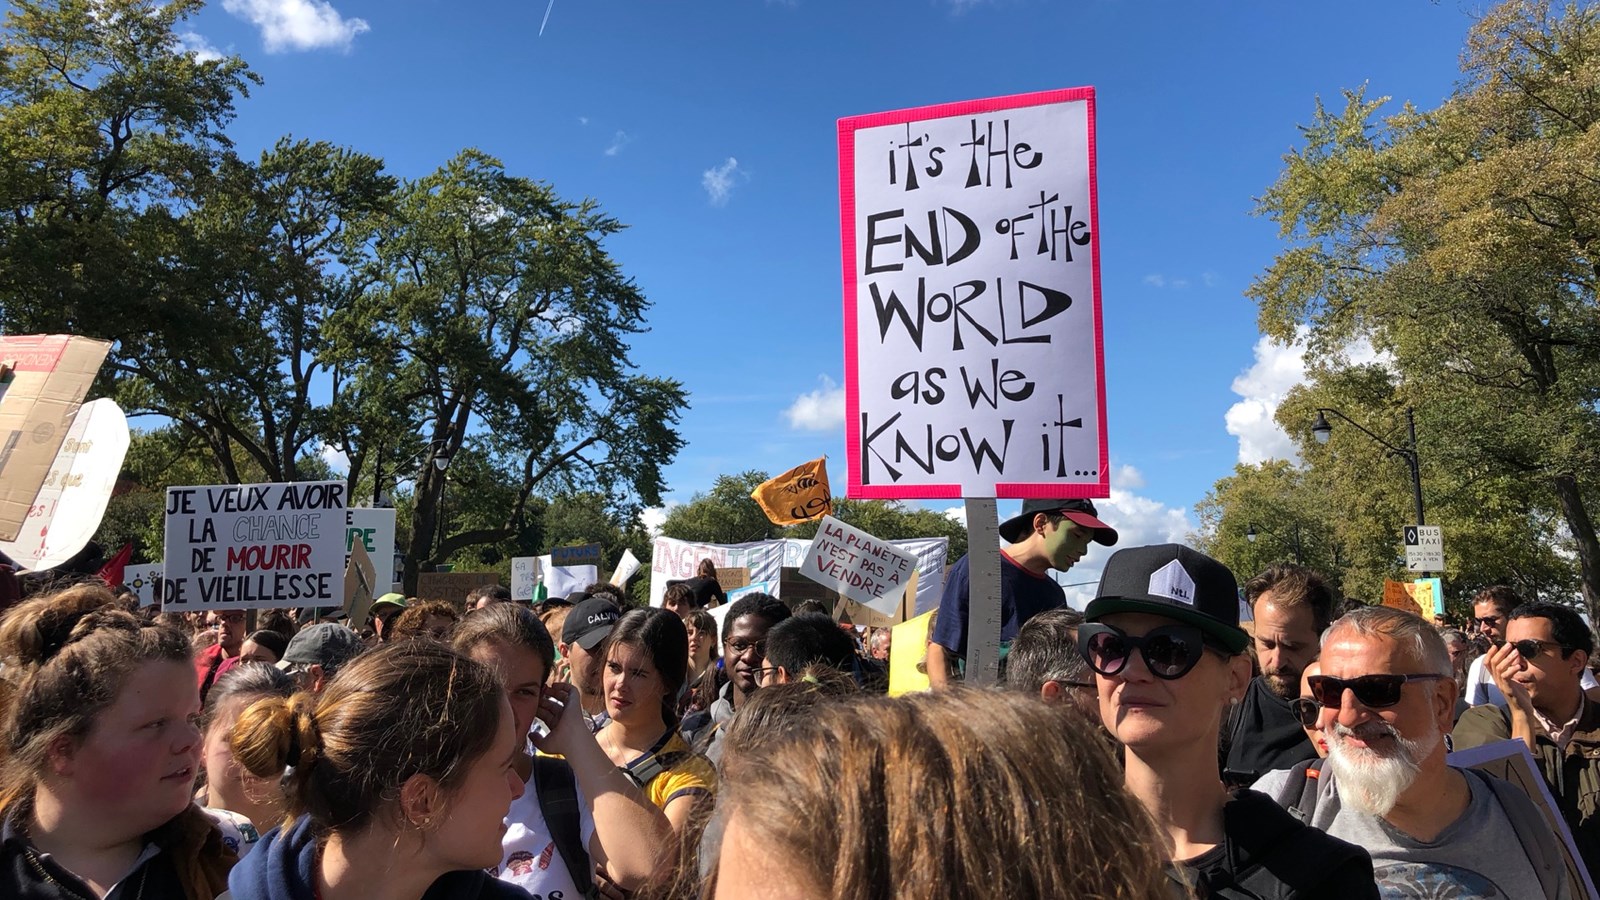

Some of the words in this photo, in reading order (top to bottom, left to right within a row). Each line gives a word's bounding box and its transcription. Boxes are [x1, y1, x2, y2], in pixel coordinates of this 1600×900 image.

[889, 122, 946, 191] it's
[864, 206, 981, 276] END
[891, 367, 947, 405] as
[1042, 393, 1097, 478] it...
[166, 489, 196, 515] JE
[207, 486, 271, 513] VEUX
[277, 483, 344, 511] AVOIR
[189, 518, 217, 544] LA
[232, 512, 322, 543] CHANCE
[824, 523, 844, 541] LA
[846, 533, 909, 571] PLANÈTE
[191, 547, 216, 573] DE
[226, 543, 313, 572] MOURIR
[816, 539, 859, 564] N'EST
[860, 558, 885, 578] PAS
[888, 571, 900, 586] À
[817, 555, 885, 599] VENDRE
[164, 577, 188, 604] DE
[198, 573, 332, 603] VIEILLESSE
[587, 611, 619, 624] CALVIN
